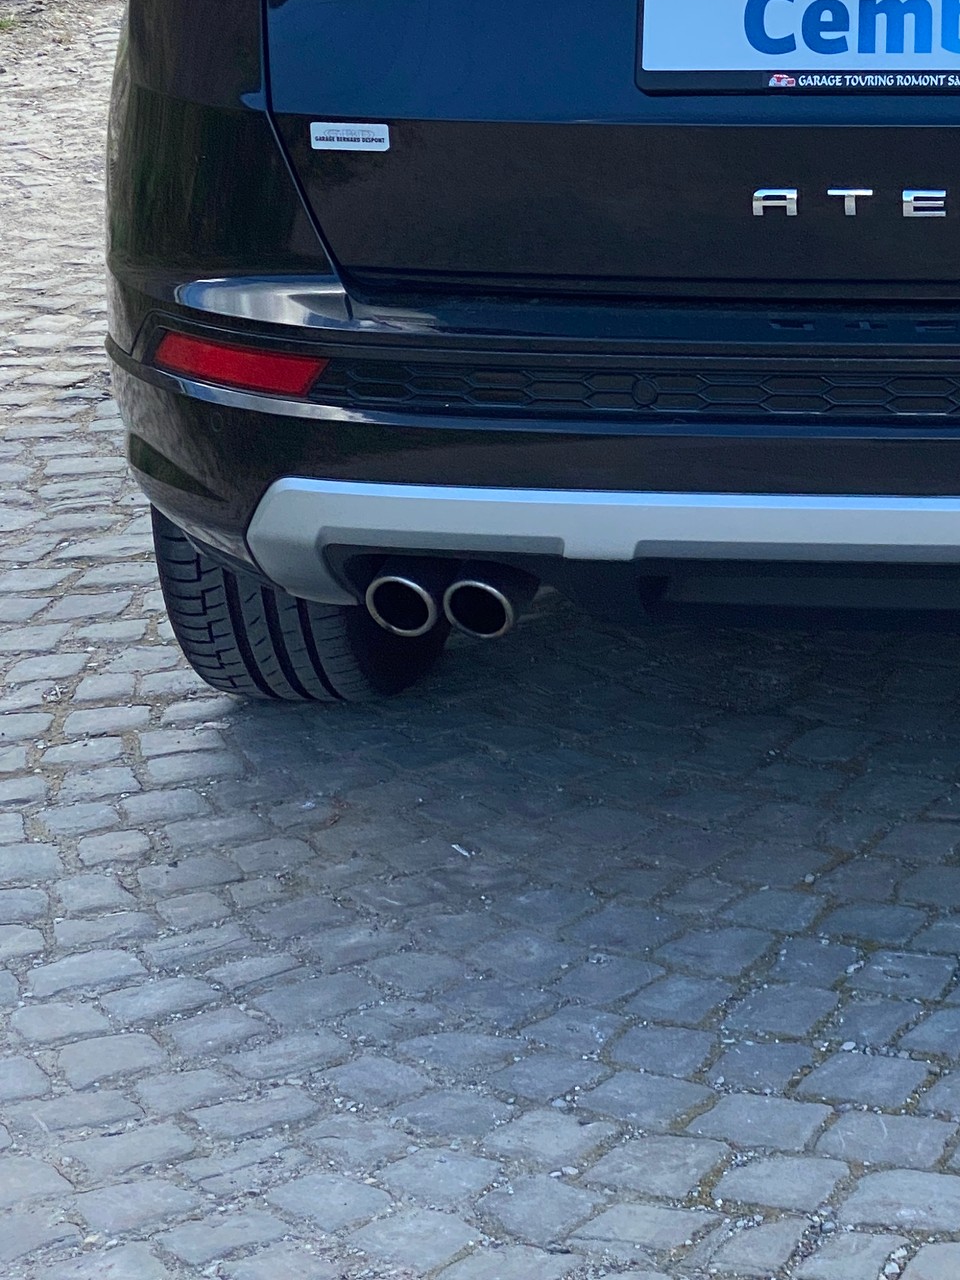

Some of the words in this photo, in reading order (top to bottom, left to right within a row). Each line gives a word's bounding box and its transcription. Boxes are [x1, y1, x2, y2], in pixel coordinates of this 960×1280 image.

[798, 75, 843, 86] GARAGE
[844, 75, 894, 86] TOURING
[896, 75, 947, 86] ROMONT
